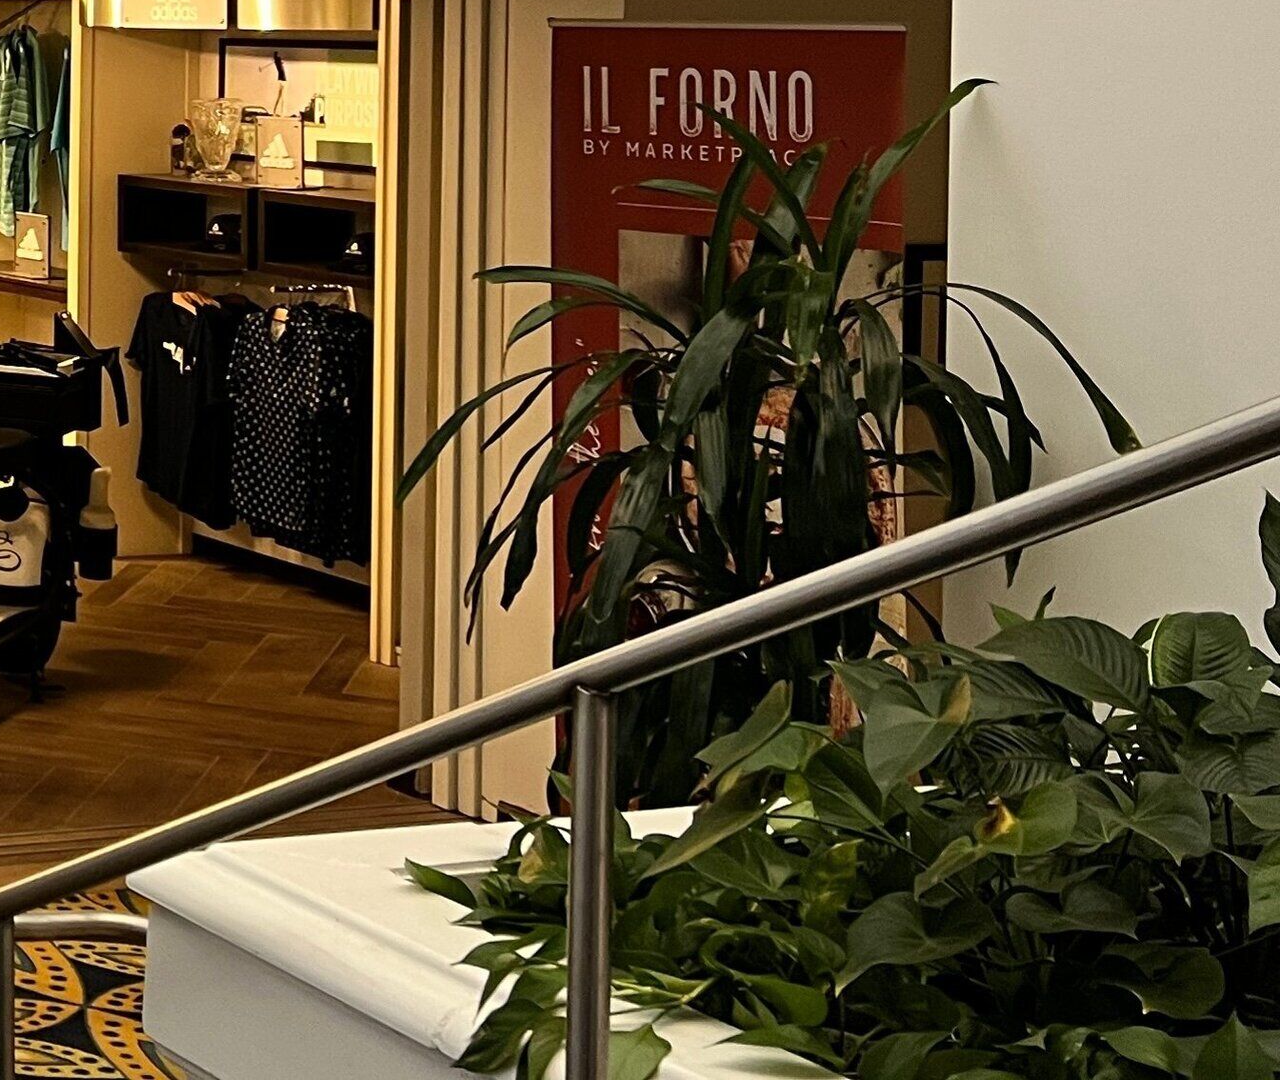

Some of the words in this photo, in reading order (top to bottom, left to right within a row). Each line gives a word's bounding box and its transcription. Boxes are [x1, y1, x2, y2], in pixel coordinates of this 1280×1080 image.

[583, 65, 621, 134] IL
[649, 67, 814, 143] FORNO
[583, 139, 611, 156] BY
